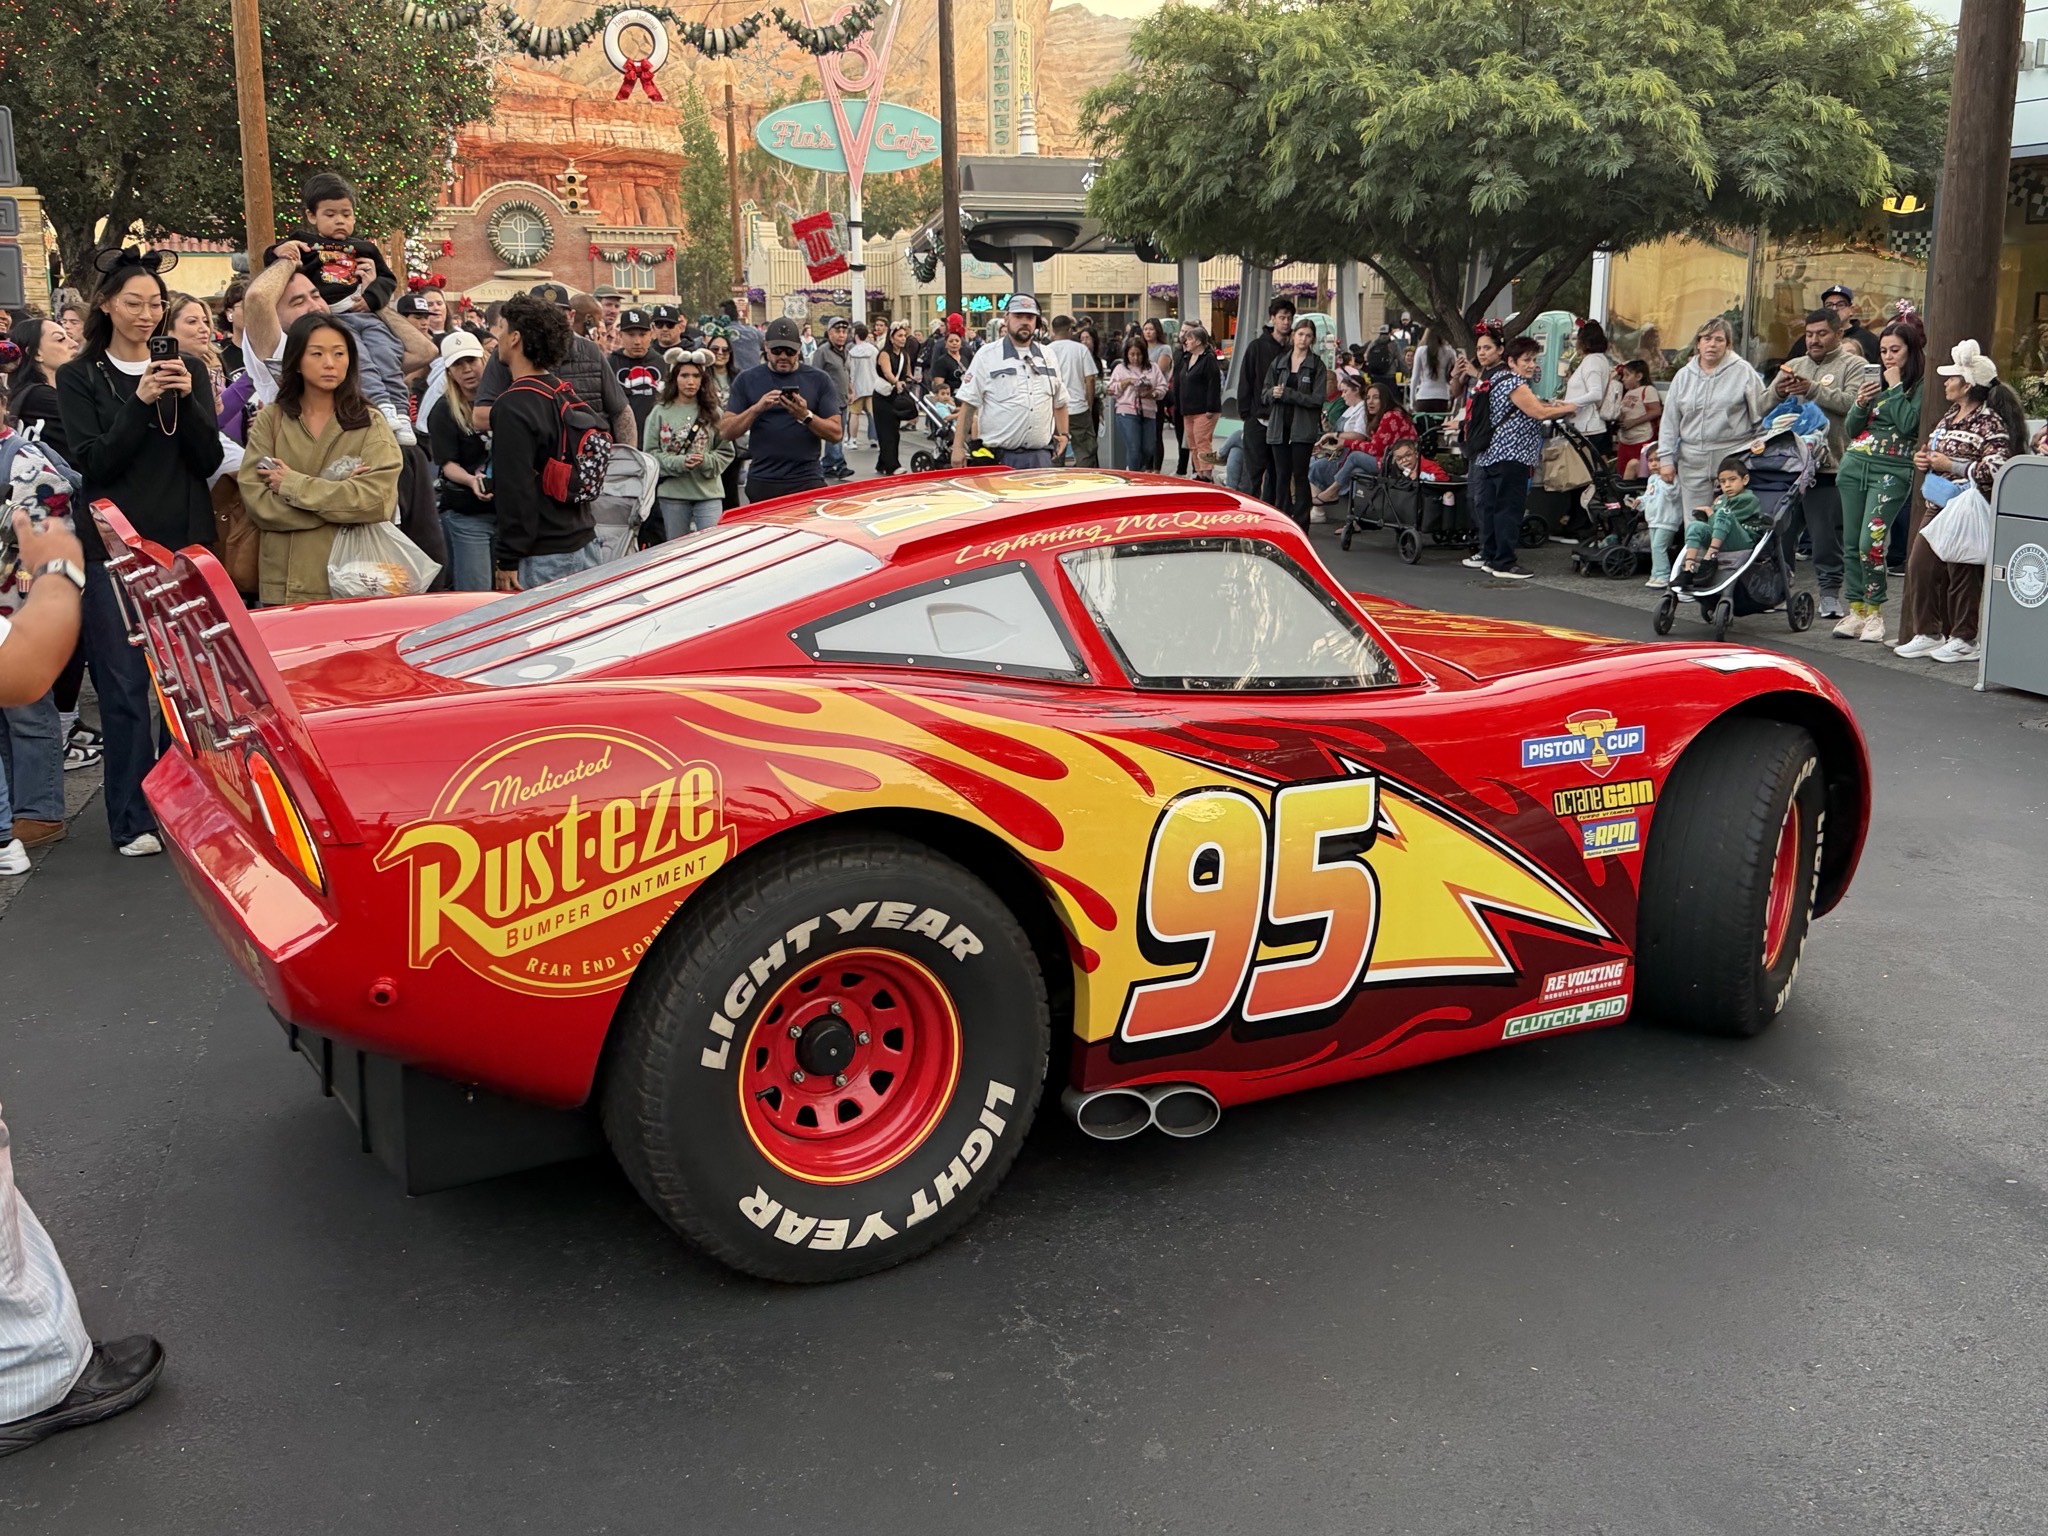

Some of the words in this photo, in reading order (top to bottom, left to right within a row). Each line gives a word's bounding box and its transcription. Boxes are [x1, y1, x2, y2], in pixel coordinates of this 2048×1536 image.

[771, 120, 836, 150] Flo's
[875, 122, 939, 160] Cafe
[804, 229, 836, 263] OIL
[955, 524, 1107, 565] Lightning
[1114, 510, 1266, 534] McQueen
[1528, 738, 1586, 760] PISTON
[1606, 732, 1640, 751] CUP
[480, 745, 612, 813] Medicated
[1594, 820, 1637, 847] RPM
[506, 904, 590, 950] BUMPER
[603, 855, 708, 911] OINTMENT
[1117, 774, 1379, 1046] 95
[526, 956, 571, 978] REAR
[582, 955, 616, 975] END
[1543, 989, 1573, 1001] REBUILT
[1574, 979, 1622, 994] ALTERNATORS
